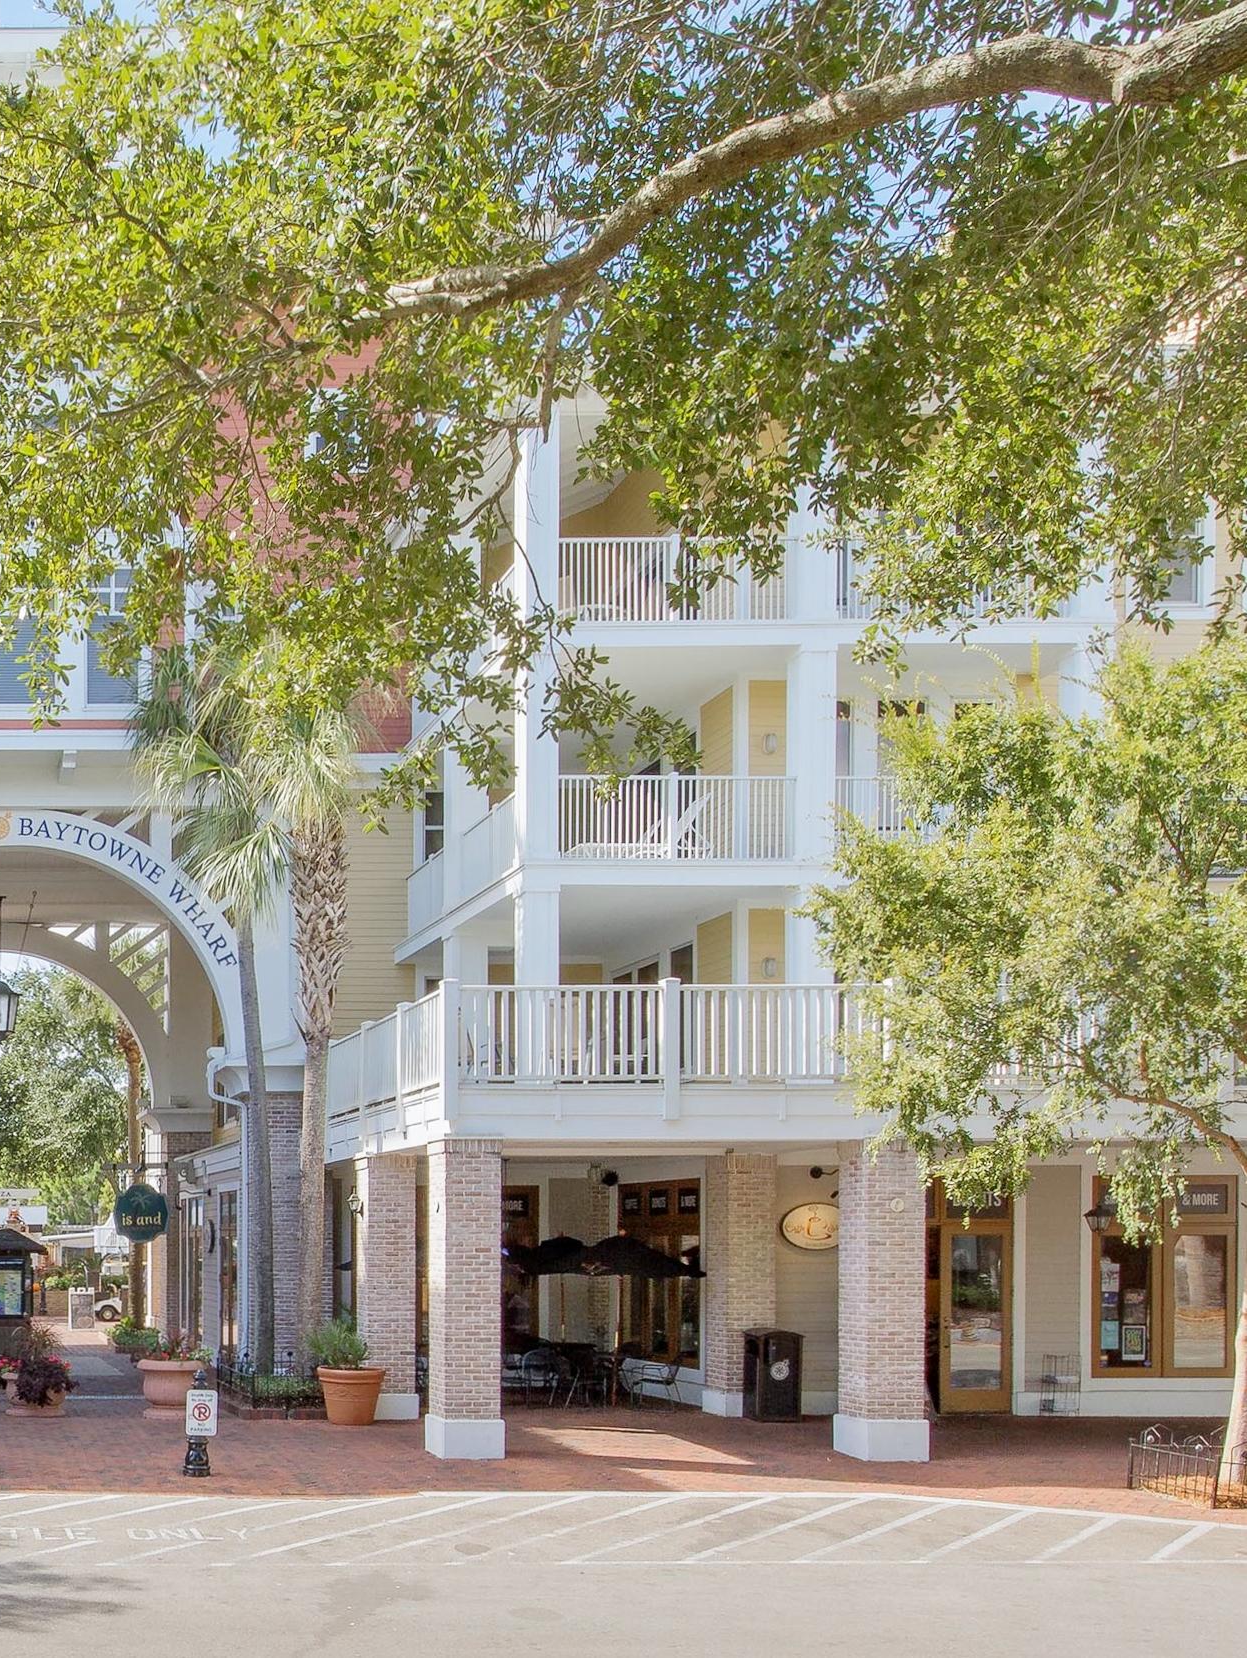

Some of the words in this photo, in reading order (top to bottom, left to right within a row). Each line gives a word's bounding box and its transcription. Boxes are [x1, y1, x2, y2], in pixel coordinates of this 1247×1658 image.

[18, 817, 166, 885] BAYTOWNE
[168, 879, 238, 967] WHARF
[1192, 1193, 1219, 1206] MORE
[121, 1212, 133, 1226] is
[136, 1211, 162, 1226] and
[127, 1527, 248, 1541] ONLY
